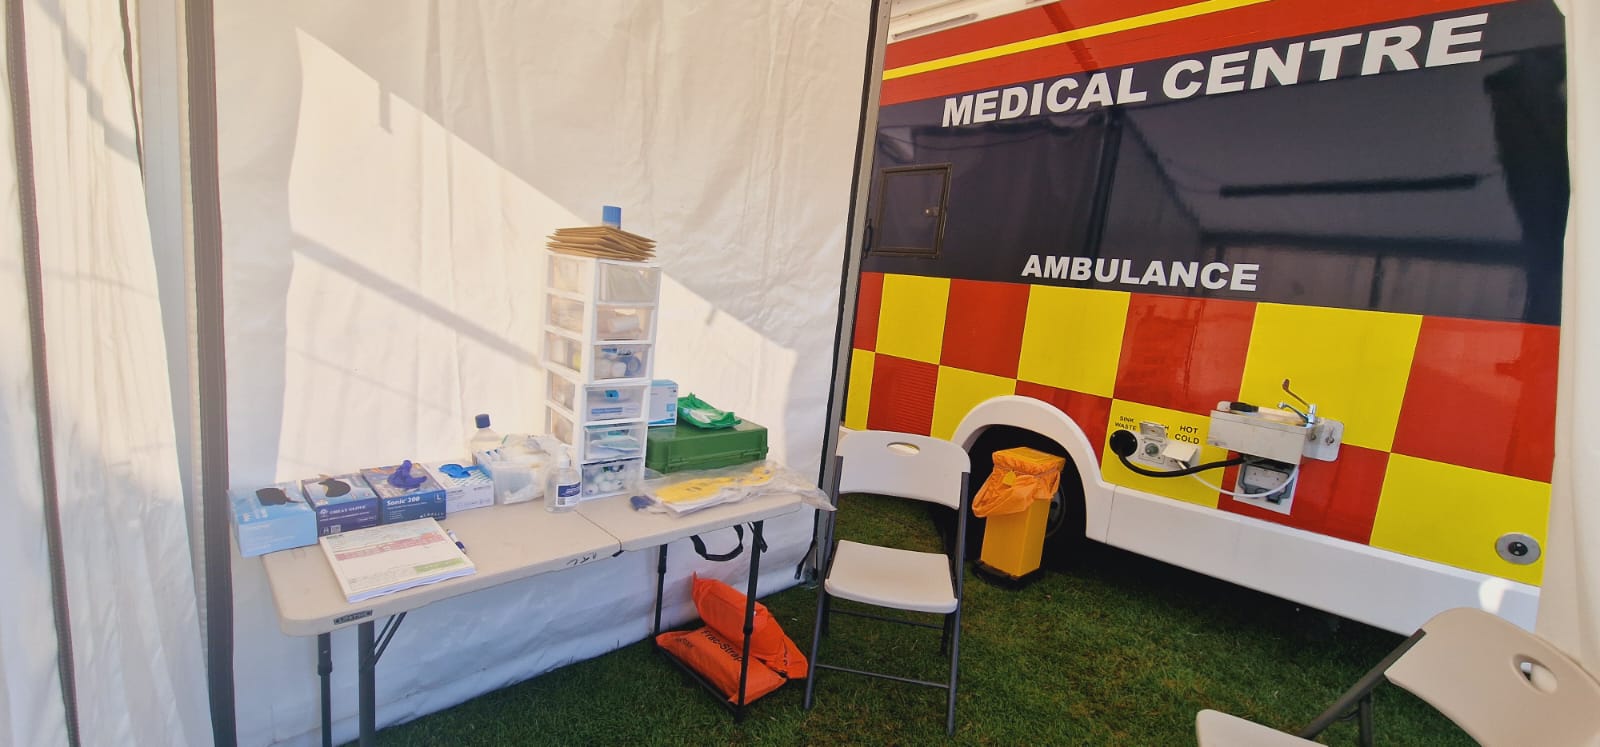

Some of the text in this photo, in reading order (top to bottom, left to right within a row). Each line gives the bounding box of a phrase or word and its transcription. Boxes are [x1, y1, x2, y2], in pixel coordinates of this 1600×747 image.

[942, 12, 1489, 128] MEDICAL CENTRE
[1021, 254, 1260, 292] AMBULANCE
[1120, 415, 1134, 423] SINK
[1115, 422, 1136, 431] WASTE
[1179, 425, 1198, 434] HOT
[1175, 433, 1200, 444] COLD
[386, 497, 406, 507] Sonic
